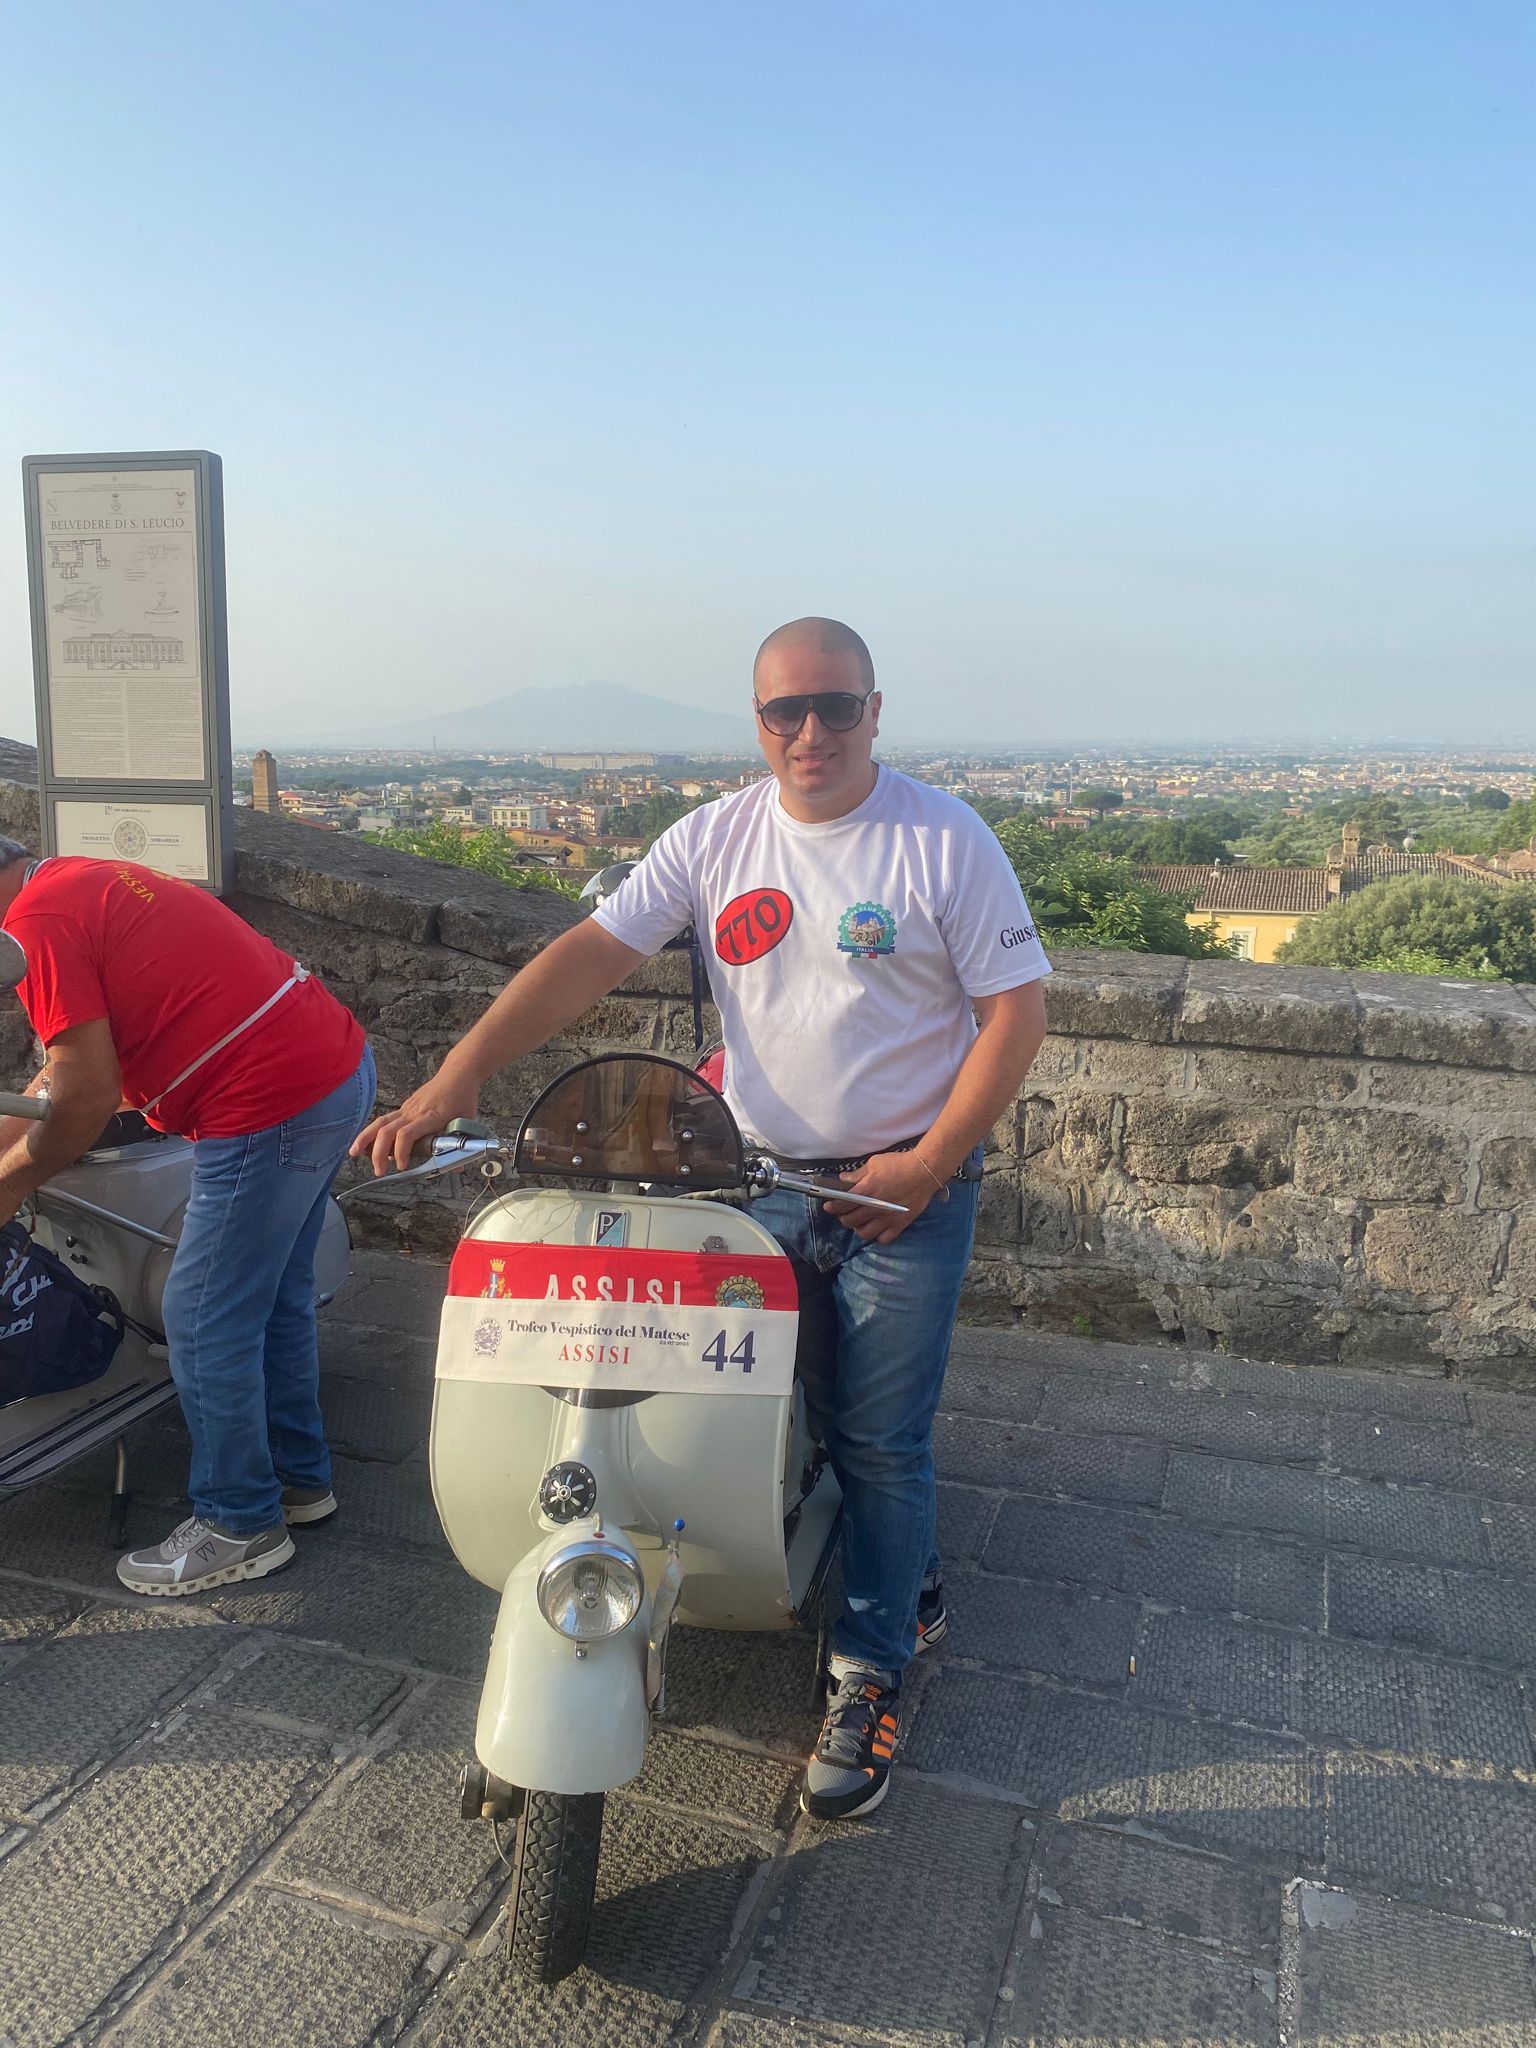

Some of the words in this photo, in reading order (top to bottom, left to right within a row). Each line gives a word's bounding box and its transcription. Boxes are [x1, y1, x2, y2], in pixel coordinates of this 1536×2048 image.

[51, 520, 112, 530] BELVEDERE
[115, 519, 127, 529] DI
[130, 519, 139, 528] S.
[143, 517, 185, 528] LEUCIO
[717, 895, 782, 959] 770
[600, 1214, 614, 1235] P
[543, 1273, 681, 1305] ASSISI
[508, 1319, 547, 1333] Trofeo
[550, 1322, 612, 1337] Vespistico
[615, 1325, 636, 1337] del
[640, 1326, 690, 1341] Matese
[558, 1343, 630, 1365] ASSISI
[702, 1329, 756, 1373] 44
